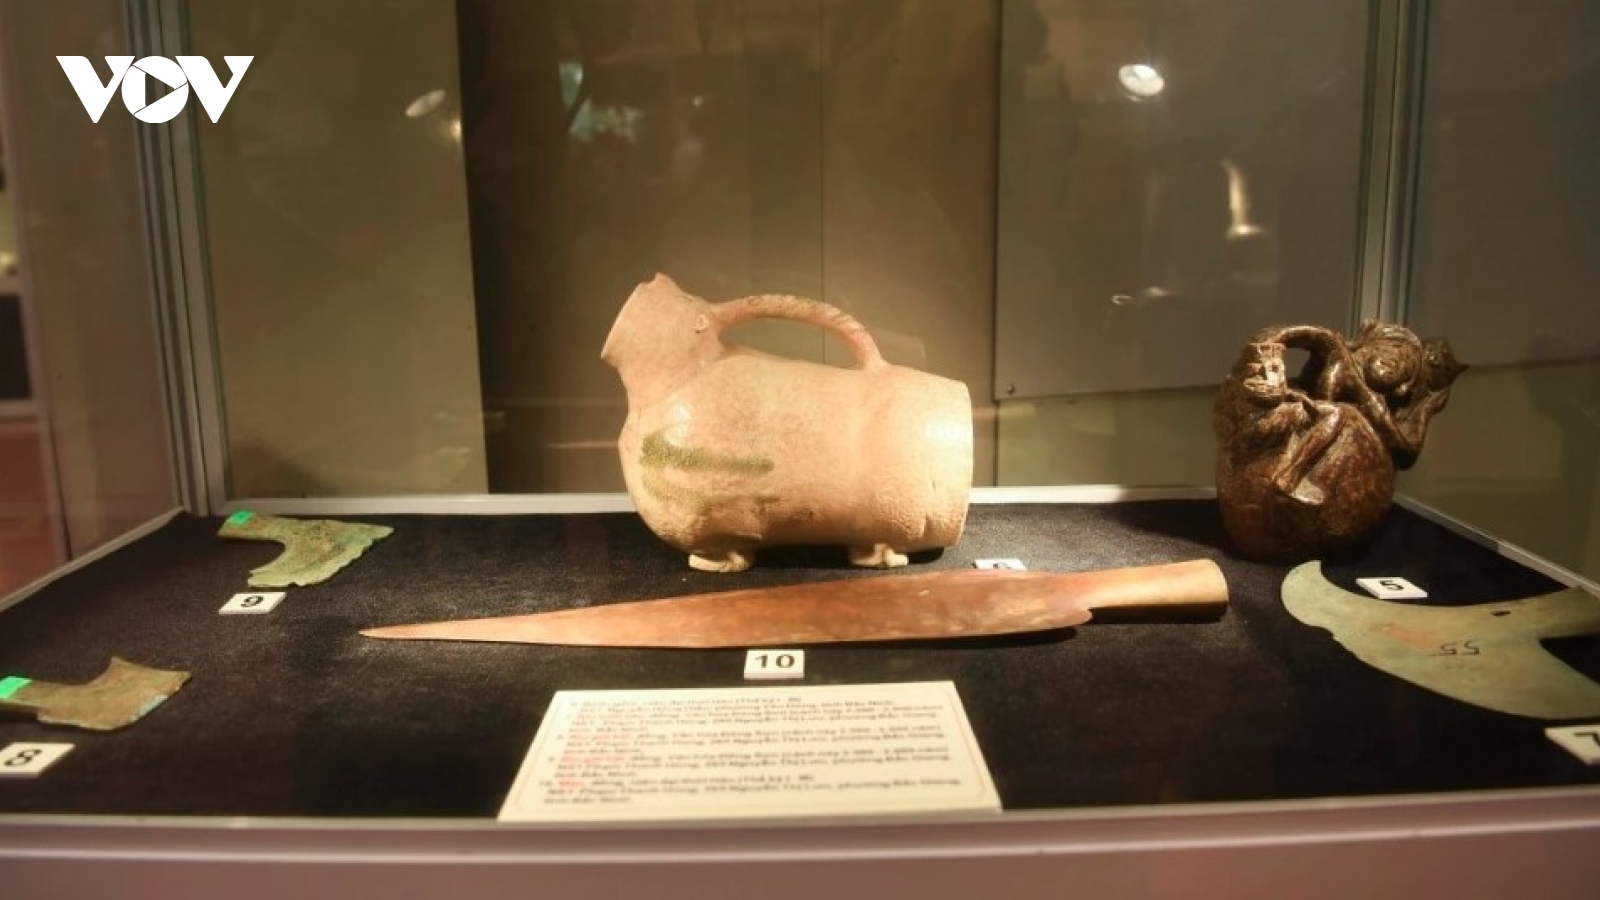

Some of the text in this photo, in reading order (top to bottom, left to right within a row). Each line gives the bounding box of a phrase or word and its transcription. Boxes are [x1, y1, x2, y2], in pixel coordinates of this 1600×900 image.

[1379, 580, 1404, 590] 5
[241, 595, 264, 608] 9
[755, 654, 795, 669] 10
[4, 749, 42, 767] 8
